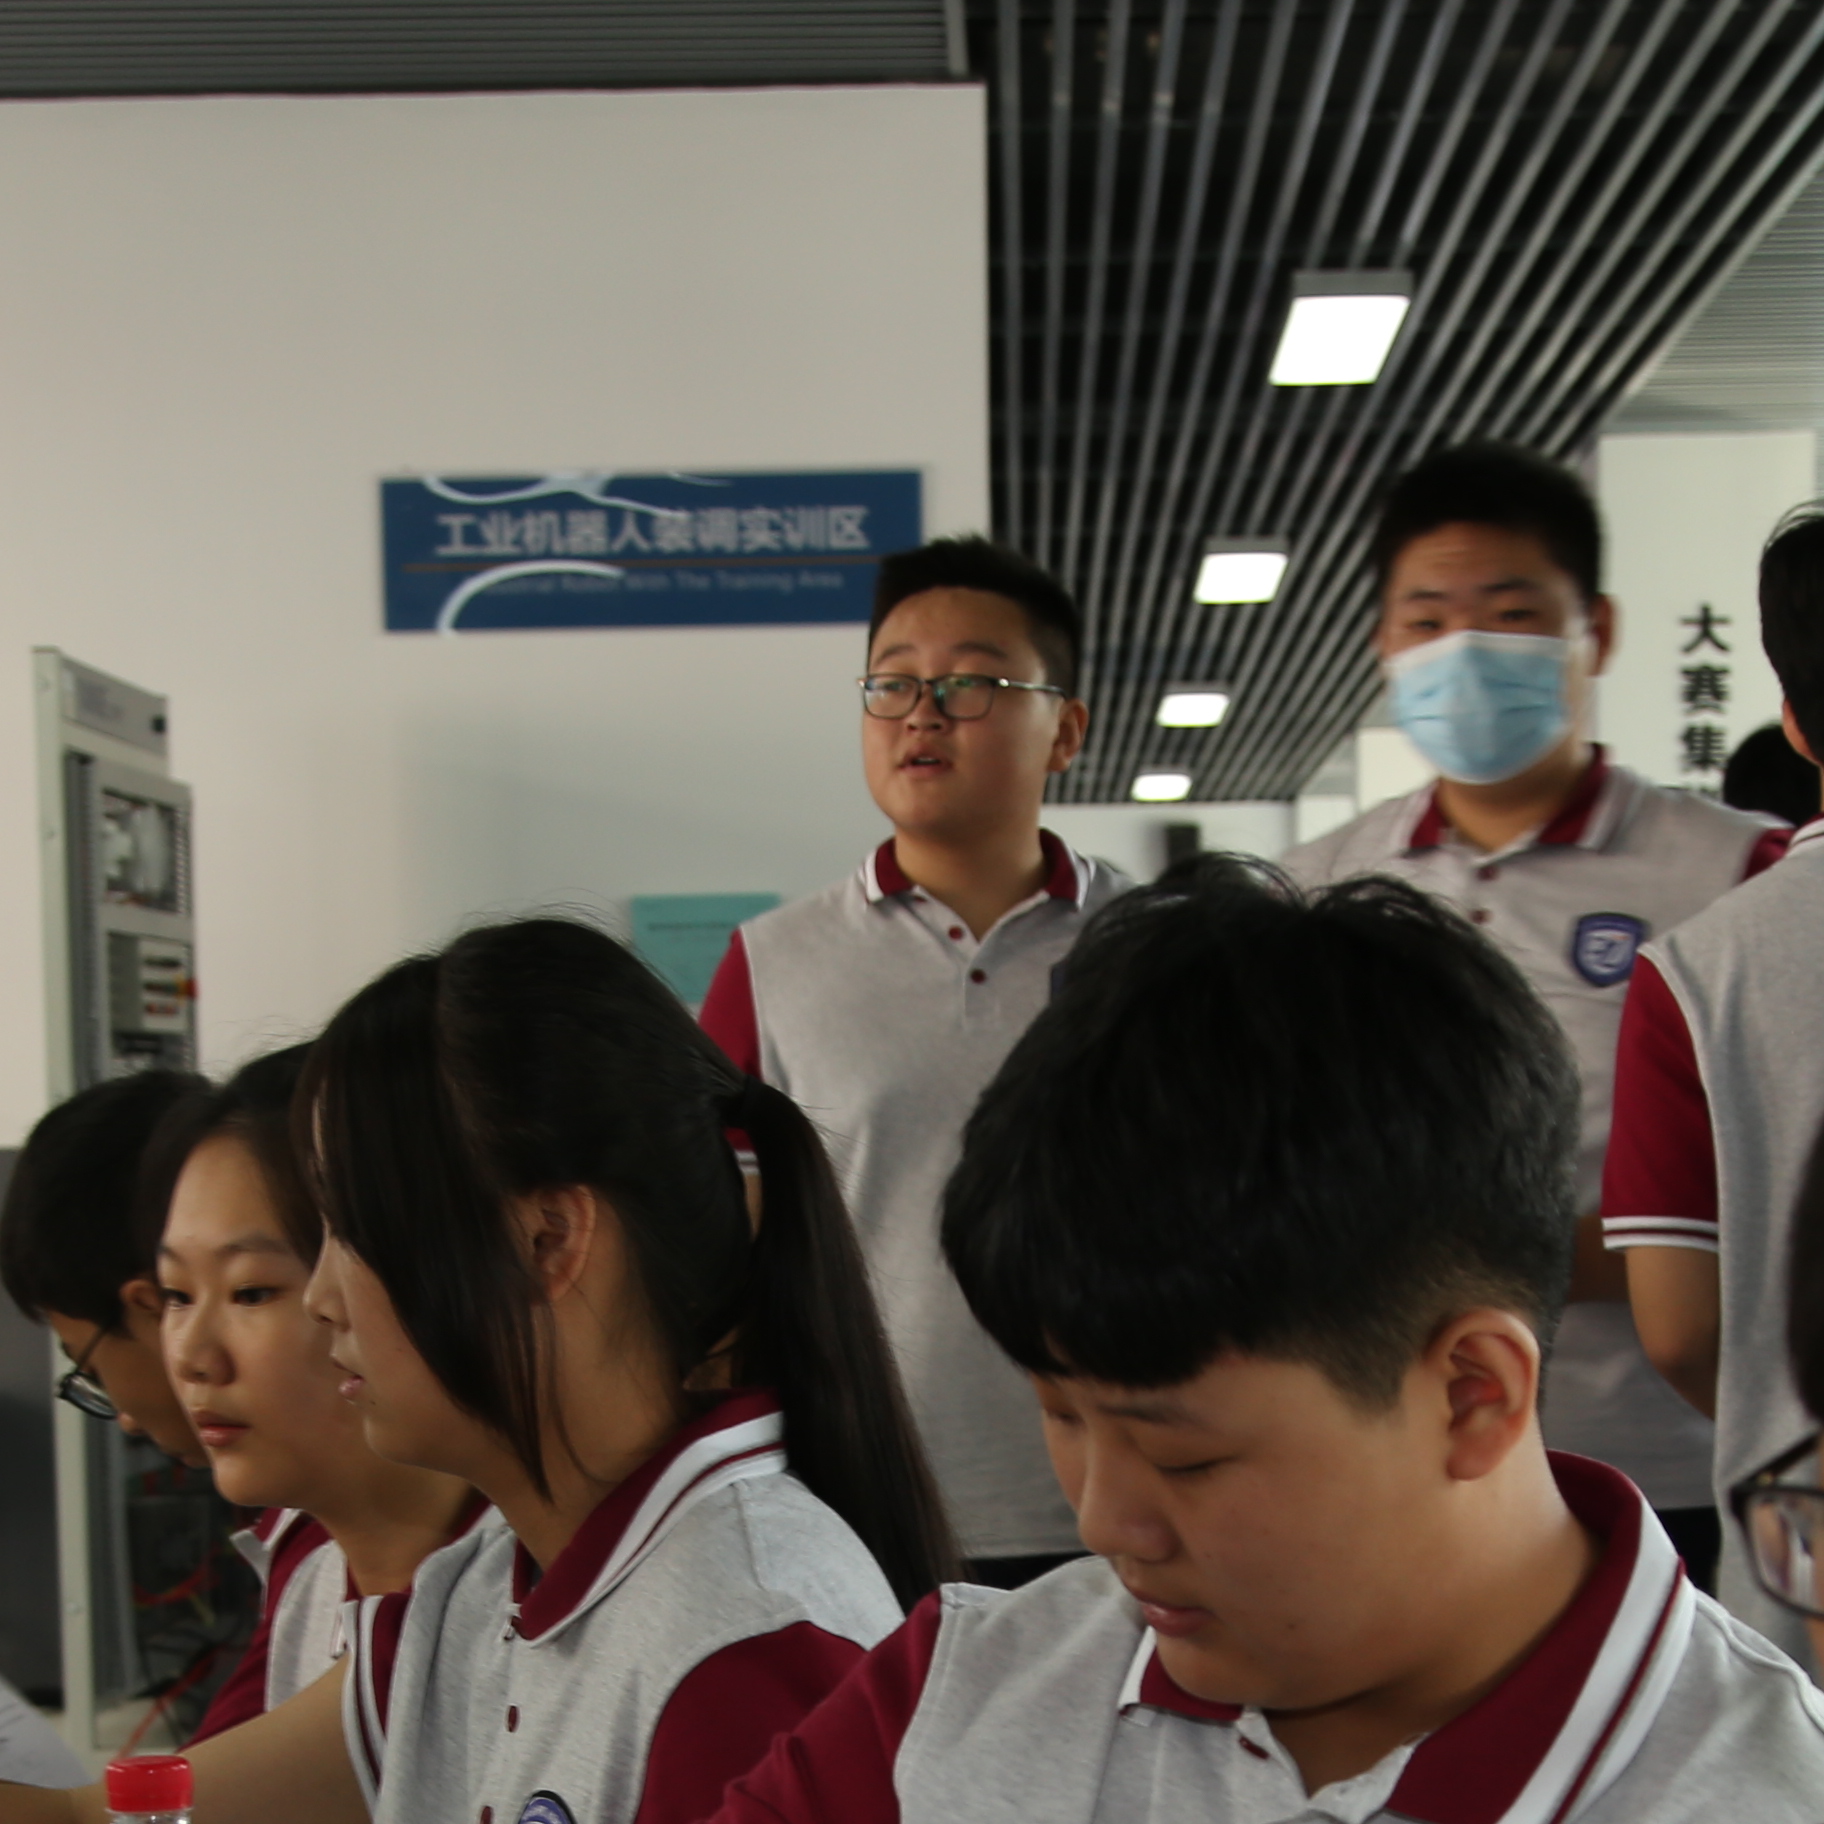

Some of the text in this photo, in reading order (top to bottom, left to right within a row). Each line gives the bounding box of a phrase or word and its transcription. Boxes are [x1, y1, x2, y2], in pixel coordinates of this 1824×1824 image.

[434, 504, 870, 557] 工业机器人装调实训区
